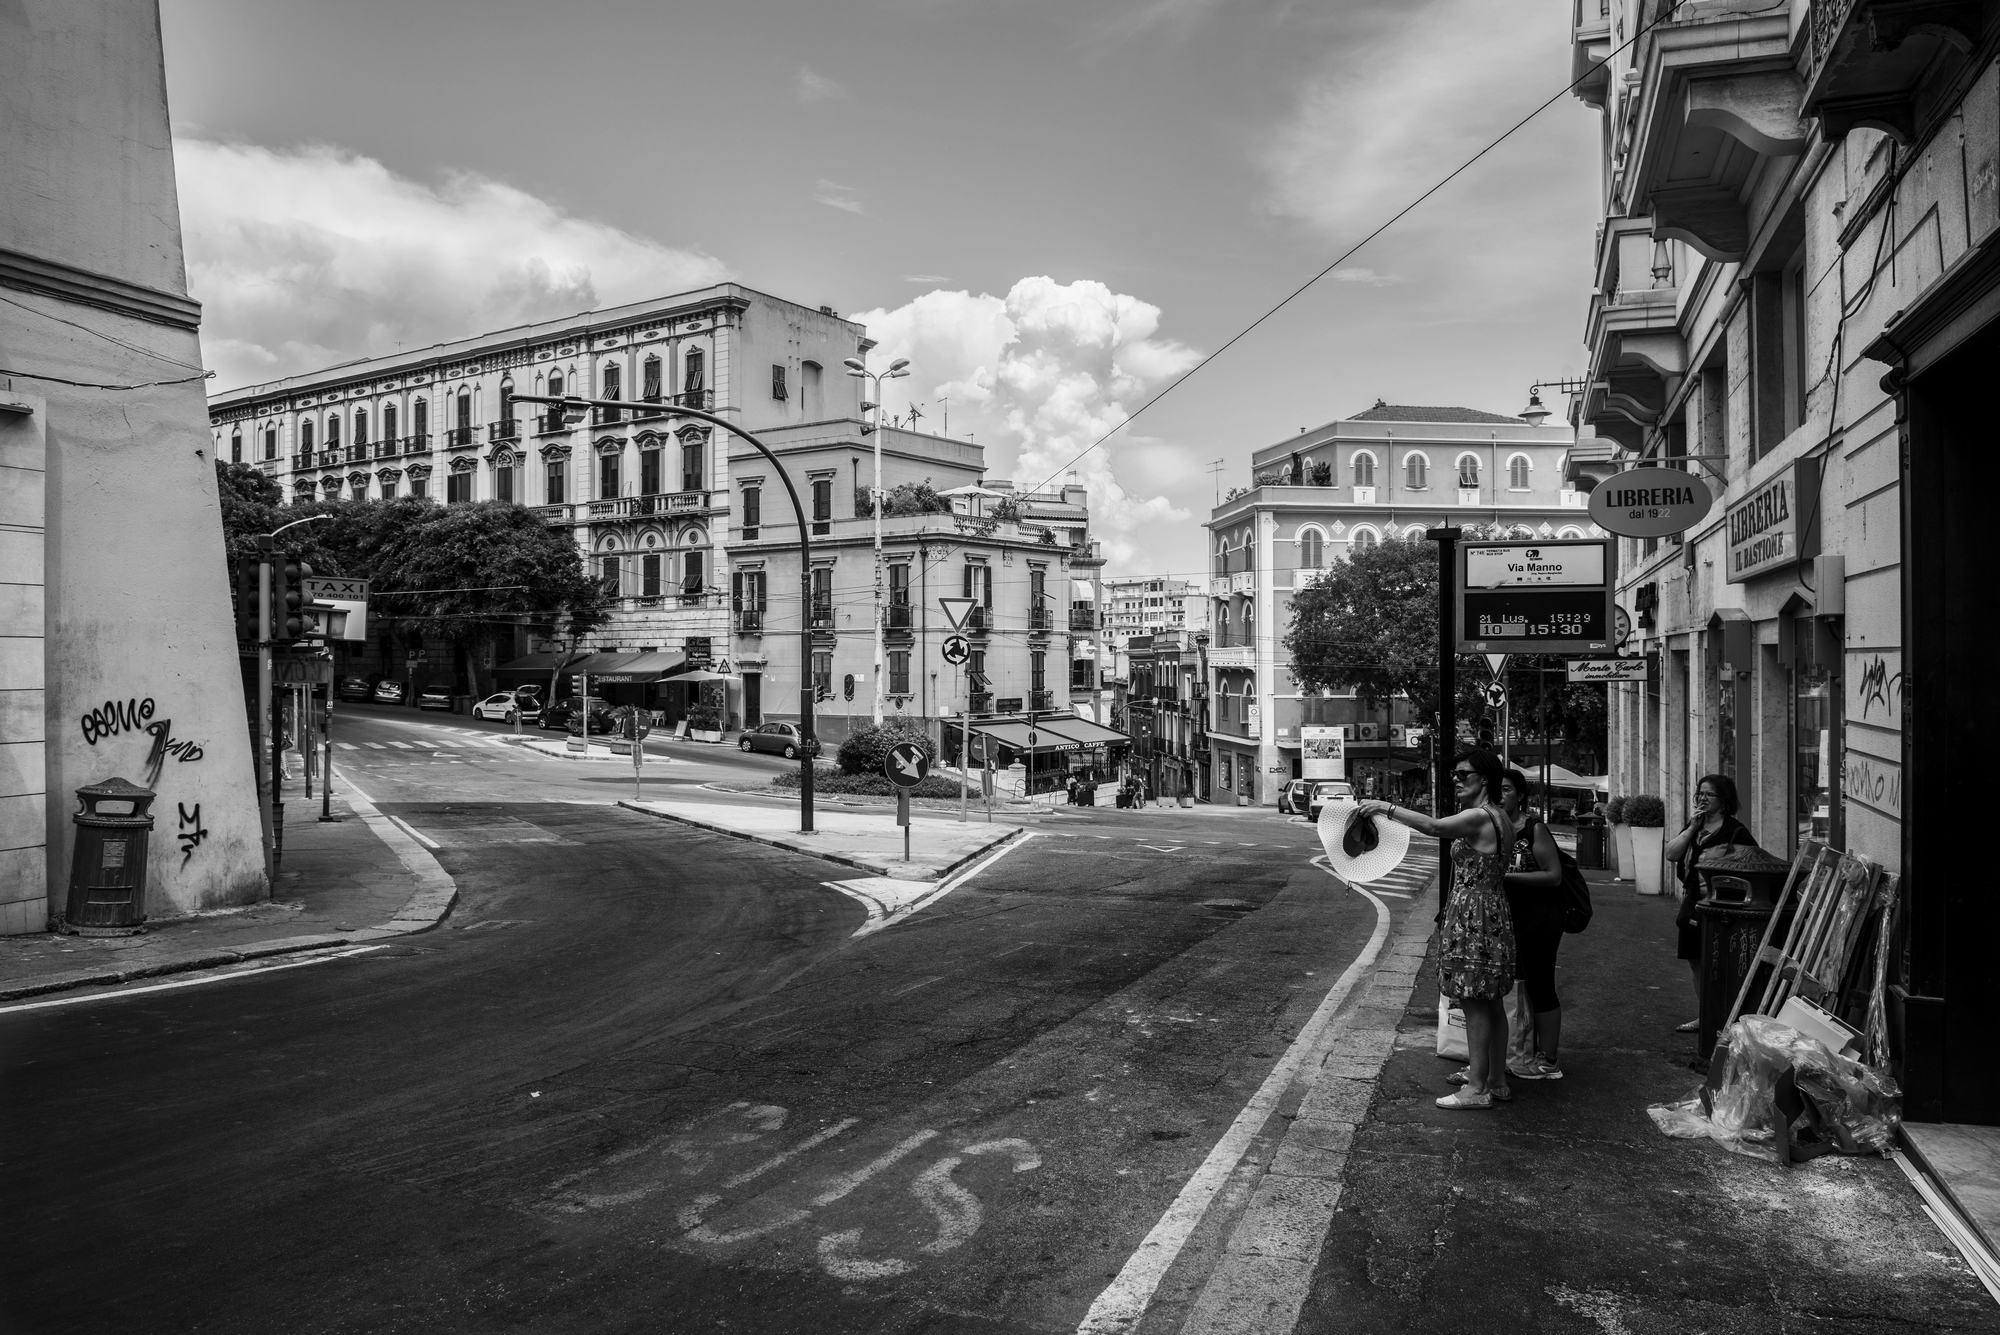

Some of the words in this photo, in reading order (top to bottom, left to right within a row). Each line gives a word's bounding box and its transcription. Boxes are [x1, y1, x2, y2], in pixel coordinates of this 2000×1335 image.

[1606, 487, 1694, 508] LIBRERIA
[1629, 509, 1644, 518] dal
[1648, 508, 1670, 518] 1922
[1730, 480, 1789, 547] LIBRERIA
[1735, 551, 1742, 572] IL
[1744, 530, 1784, 568] BASTIONE
[1508, 564, 1524, 572] Via
[1527, 563, 1562, 572] Manno
[306, 580, 364, 593] TAXI
[1480, 614, 1492, 623] 21
[1550, 614, 1591, 623] 15:29
[1483, 625, 1502, 634] 10
[1530, 624, 1582, 634] 15:30
[409, 650, 416, 659] P
[1570, 662, 1611, 672] Monte
[1615, 661, 1644, 671] Carlo
